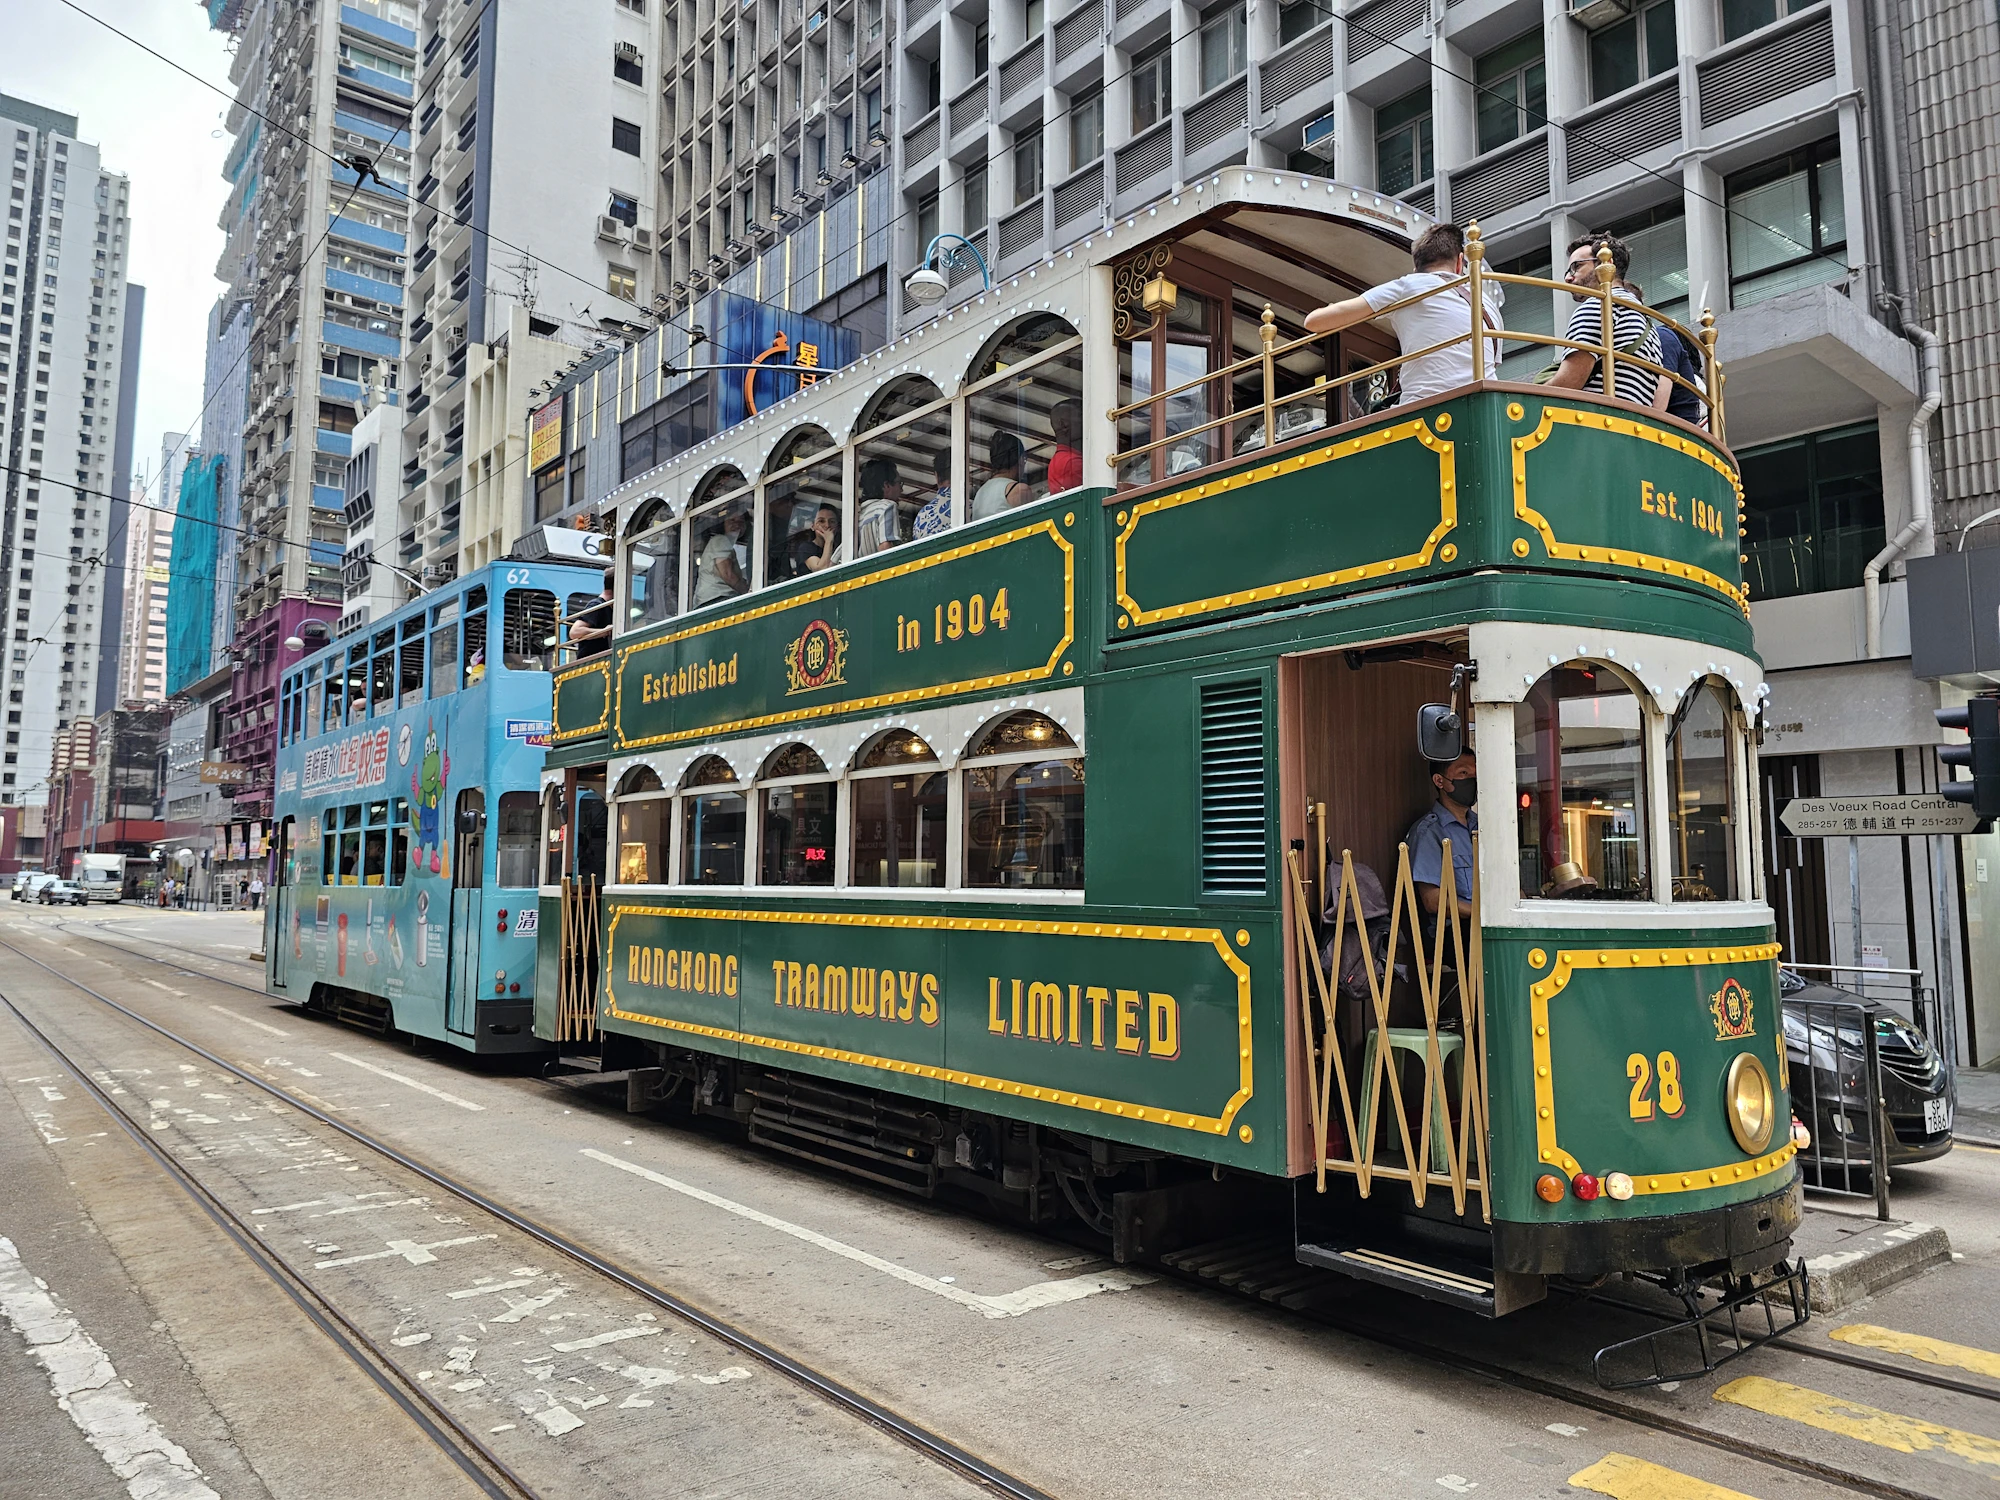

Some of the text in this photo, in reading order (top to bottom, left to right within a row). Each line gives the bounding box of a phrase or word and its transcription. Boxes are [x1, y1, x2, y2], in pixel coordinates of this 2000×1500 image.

[536, 423, 558, 444] TO LET
[1641, 480, 1724, 540] Est. 1904
[506, 568, 530, 585] 62
[642, 652, 739, 704] Established
[897, 614, 921, 653] in
[934, 587, 1010, 644] 1904
[1693, 728, 1724, 740] 中環德
[1802, 799, 1959, 813] Des Voeux Road Central
[1798, 816, 1964, 830] 285-257 德輔道中 251-237
[628, 945, 1181, 1061] HONGKONG TRAMWAYS LIMITED
[1626, 1050, 1686, 1122] 28
[1932, 1100, 1940, 1116] SP
[1928, 1114, 1947, 1132] 7886
